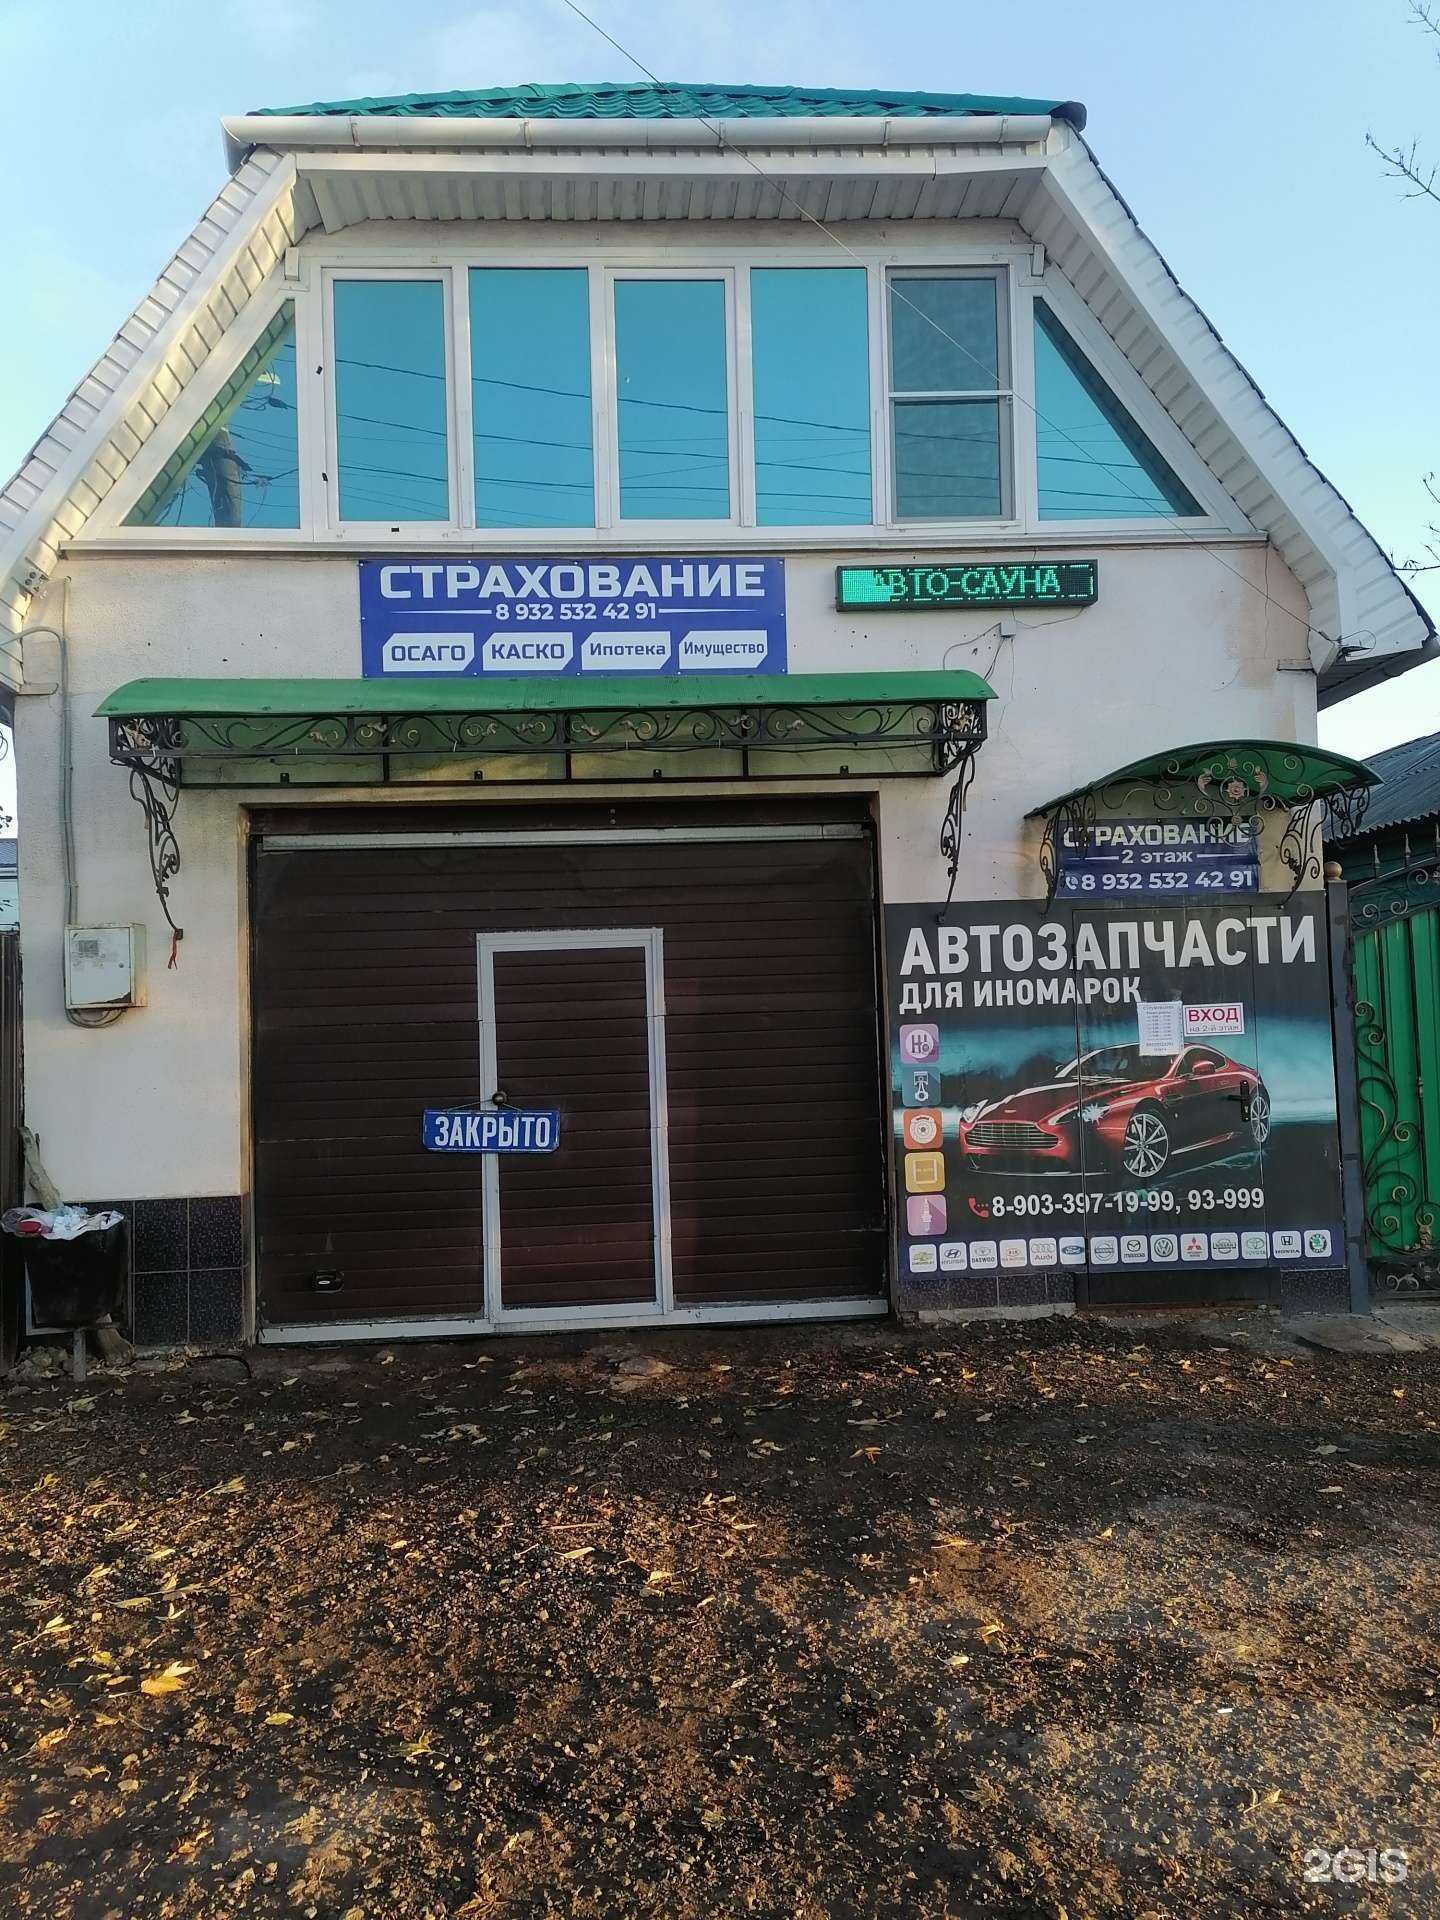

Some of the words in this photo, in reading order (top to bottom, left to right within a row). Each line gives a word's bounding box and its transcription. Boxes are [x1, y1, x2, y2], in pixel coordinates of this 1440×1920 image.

[379, 564, 766, 599] СТРАХОВАНИЕ
[495, 605, 509, 620] 8
[515, 604, 554, 620] 932
[559, 604, 597, 619] 532
[602, 604, 630, 619] 42
[635, 603, 656, 619] 91
[391, 645, 466, 661] ОСАГО
[490, 644, 565, 660] КАСКО
[589, 643, 667, 656] Ипотека
[684, 642, 765, 657] Имущество
[1121, 850, 1134, 864] 2
[1140, 851, 1193, 863] этаж
[1081, 874, 1096, 890] 8
[1102, 873, 1143, 890] 932
[1149, 873, 1189, 889] 532
[1195, 871, 1225, 888] 42
[1229, 870, 1252, 888] 91
[900, 915, 1317, 976] АВТОЗАПЧАСТИ
[899, 981, 963, 1015] ДЛЯ
[973, 976, 1142, 1006] ИНОМАРОК
[1188, 1008, 1239, 1023] ВХОД
[434, 1116, 550, 1147] ЗАКРЫТО
[992, 1190, 1181, 1217] 8-903-397-19-99,
[1188, 1187, 1265, 1211] 93-999
